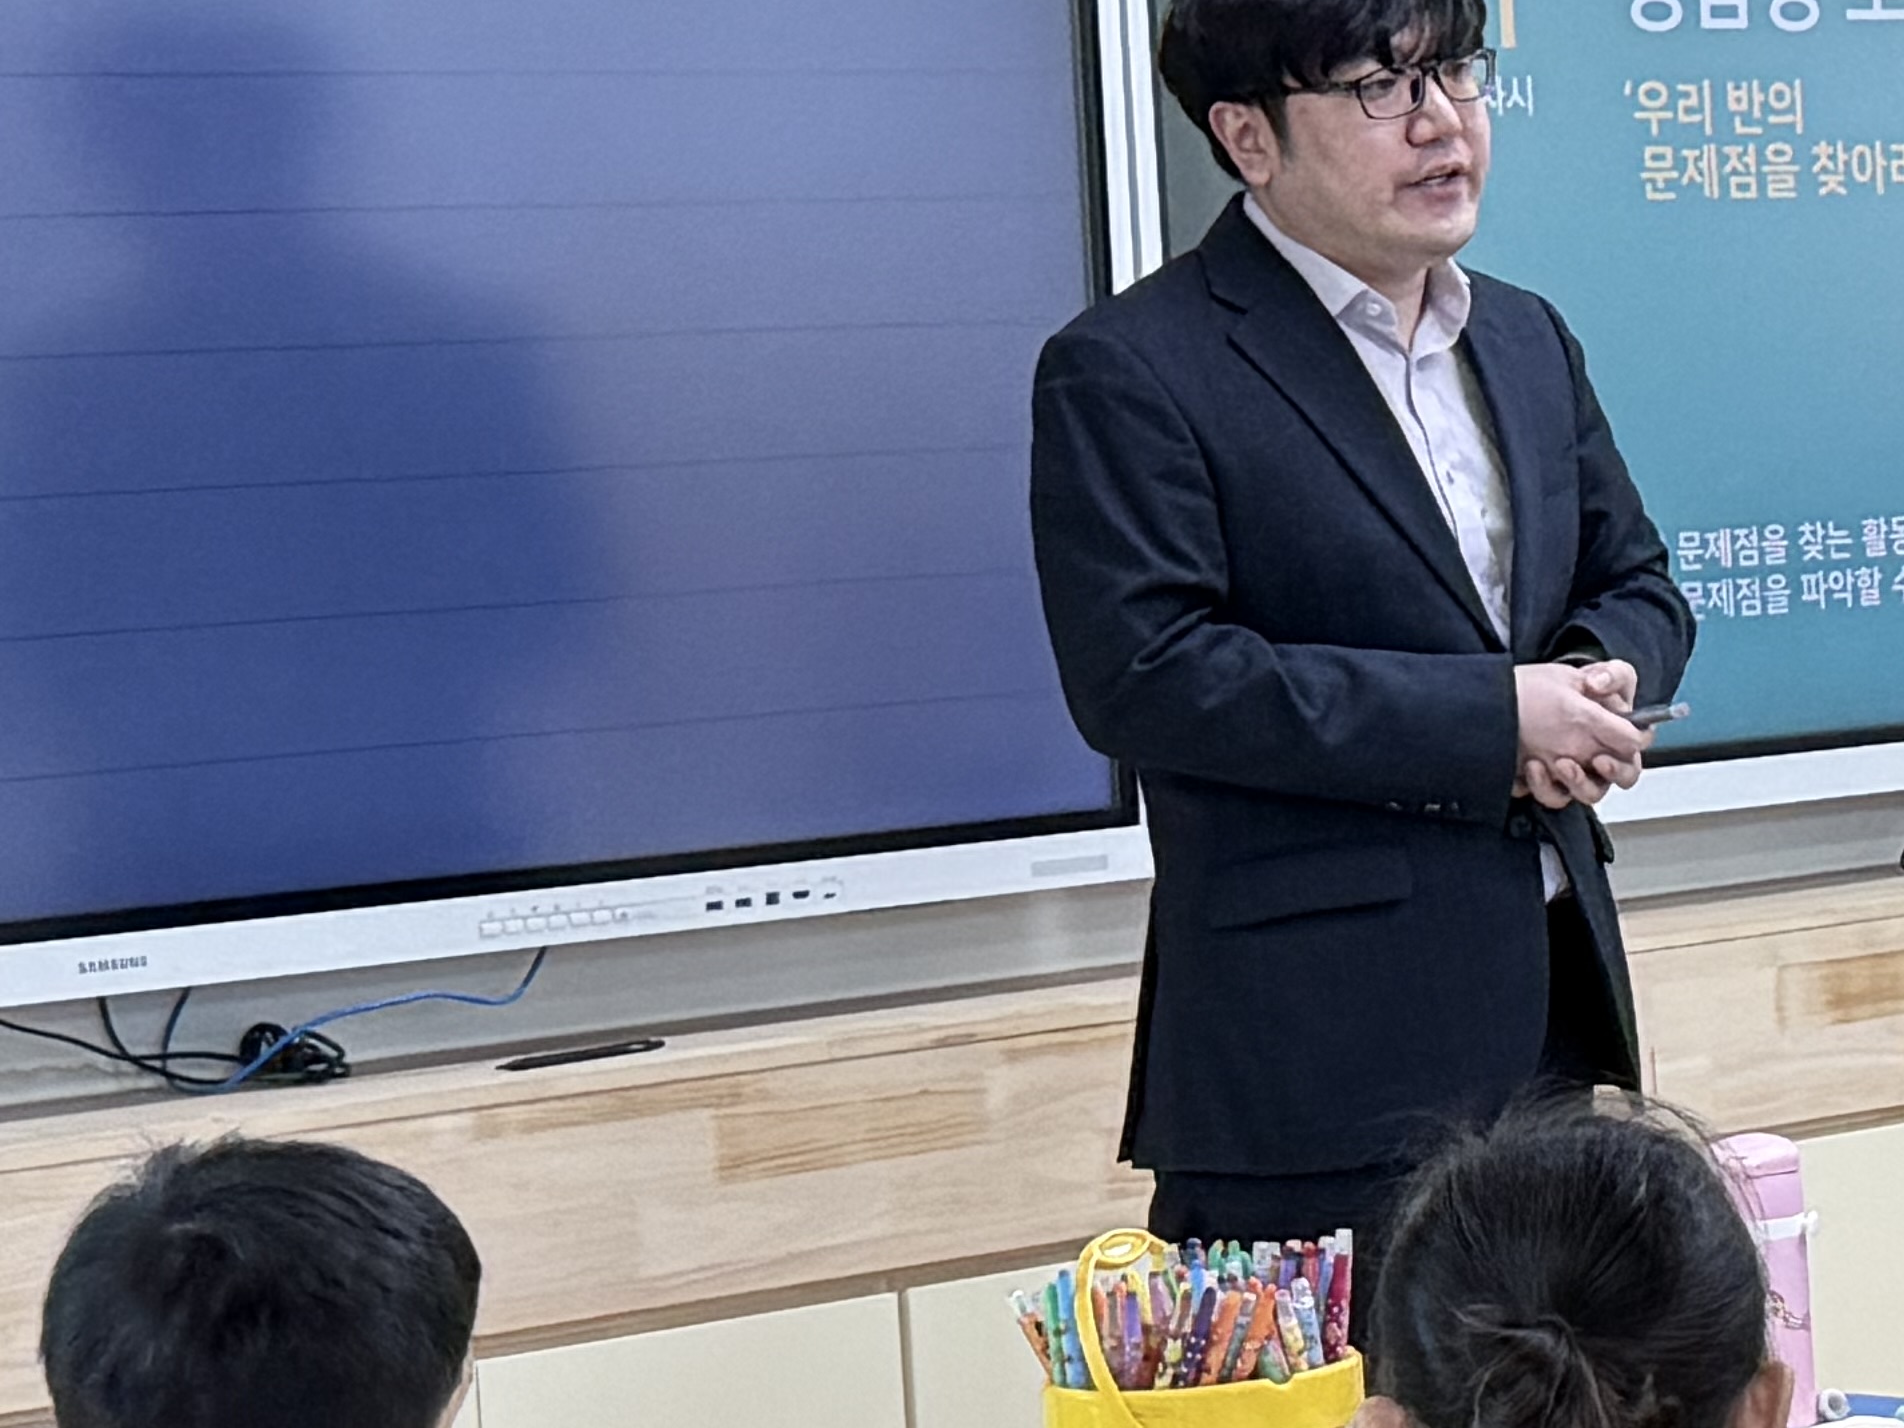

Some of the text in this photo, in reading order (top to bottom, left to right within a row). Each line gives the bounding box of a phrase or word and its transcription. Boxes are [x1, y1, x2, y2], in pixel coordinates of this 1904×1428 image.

[1726, 79, 1805, 135] 반의
[1639, 143, 1803, 202] 문제점을
[1676, 523, 1789, 571] 문제점을
[1797, 521, 1854, 562] 찾는
[1800, 566, 1883, 610] 파악할
